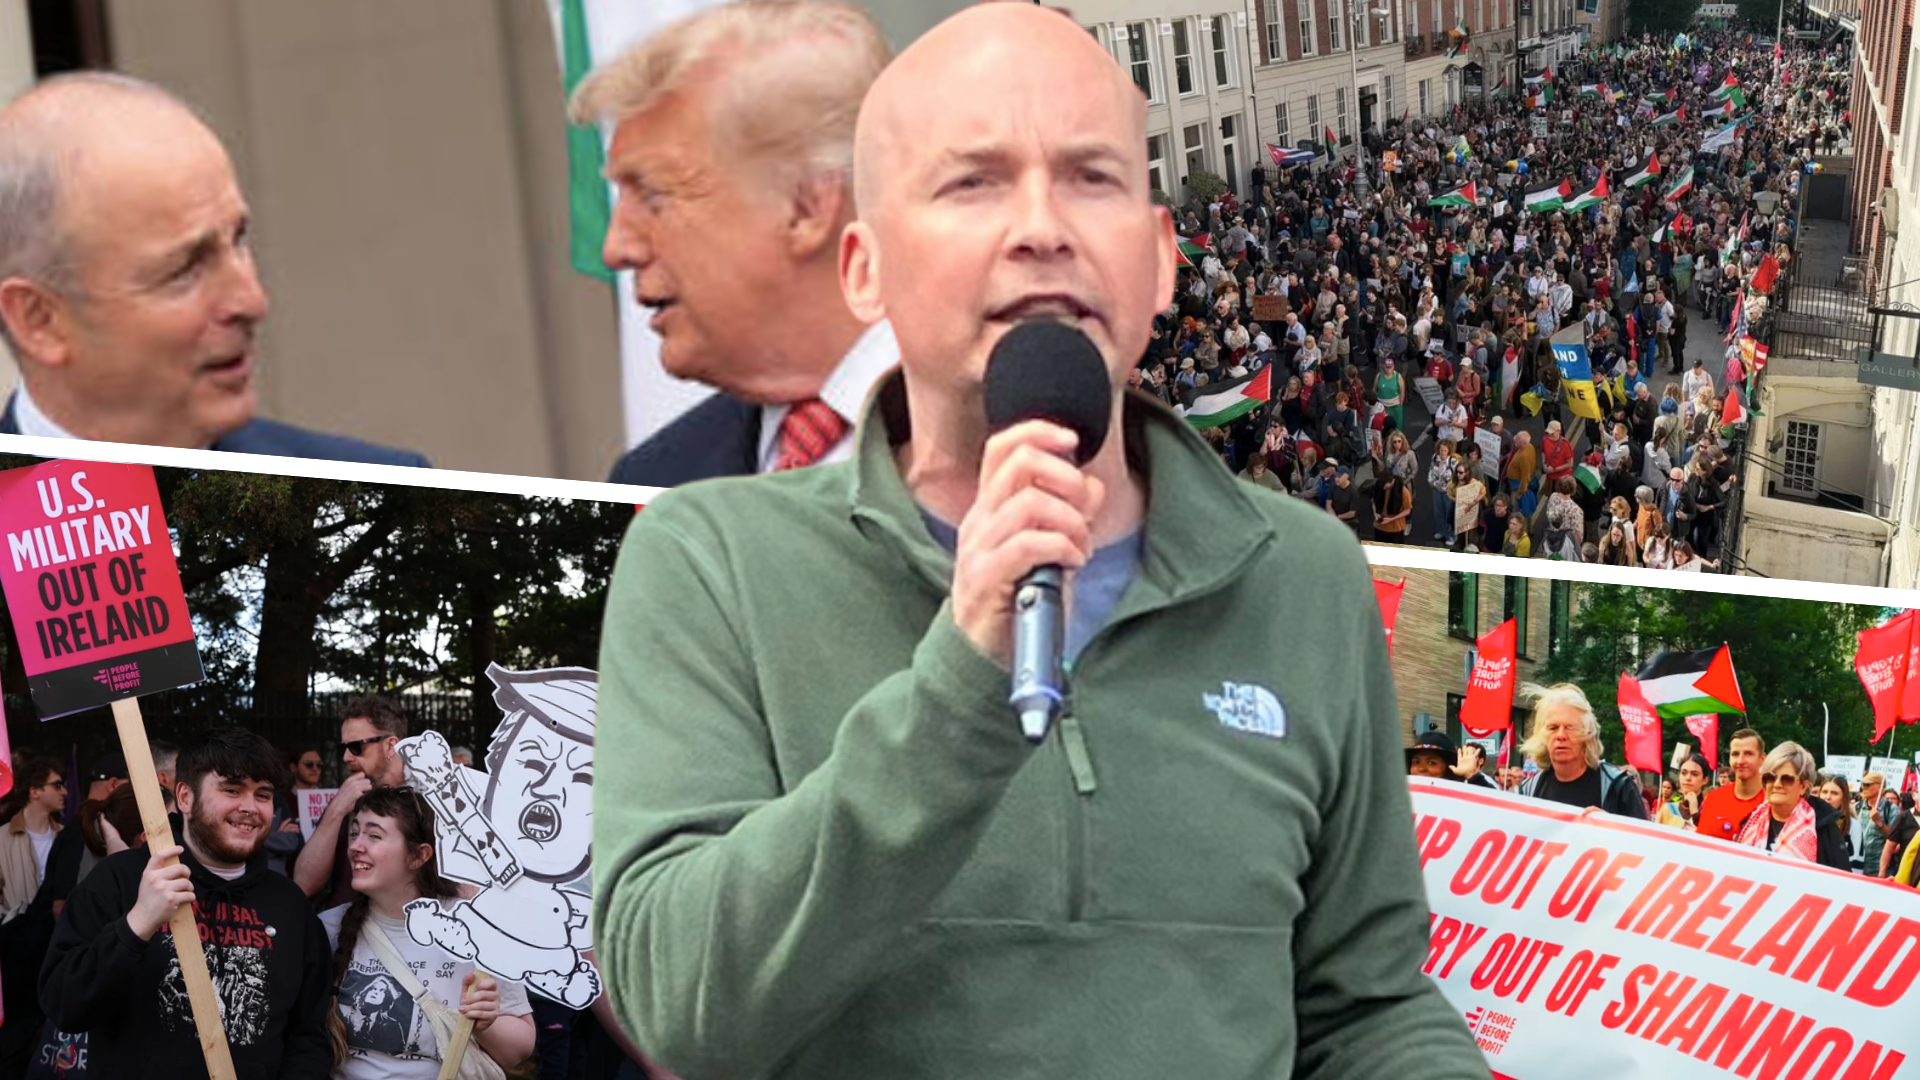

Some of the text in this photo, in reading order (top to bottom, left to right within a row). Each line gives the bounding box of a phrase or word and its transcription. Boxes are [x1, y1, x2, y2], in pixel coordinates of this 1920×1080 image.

[36, 471, 106, 519] U.S.
[7, 505, 152, 573] MILITARY
[37, 552, 147, 612] OUT OF
[35, 595, 170, 659] IRELAND
[110, 662, 139, 675] PEOPLE
[112, 670, 141, 683] BEFORE
[114, 678, 140, 691] PROFIT
[309, 793, 322, 805] NO
[1449, 829, 1568, 911] OUT
[1546, 848, 1644, 923] OF
[1615, 862, 1920, 1009] IRELAND
[435, 970, 455, 978] SAY
[442, 961, 456, 970] OF
[1470, 932, 1564, 1004] OUT
[1545, 949, 1622, 1017] OF
[1486, 1010, 1518, 1030] PEOPLE
[1480, 1024, 1511, 1043] BEFORE
[1476, 1037, 1504, 1055] PROFIT
